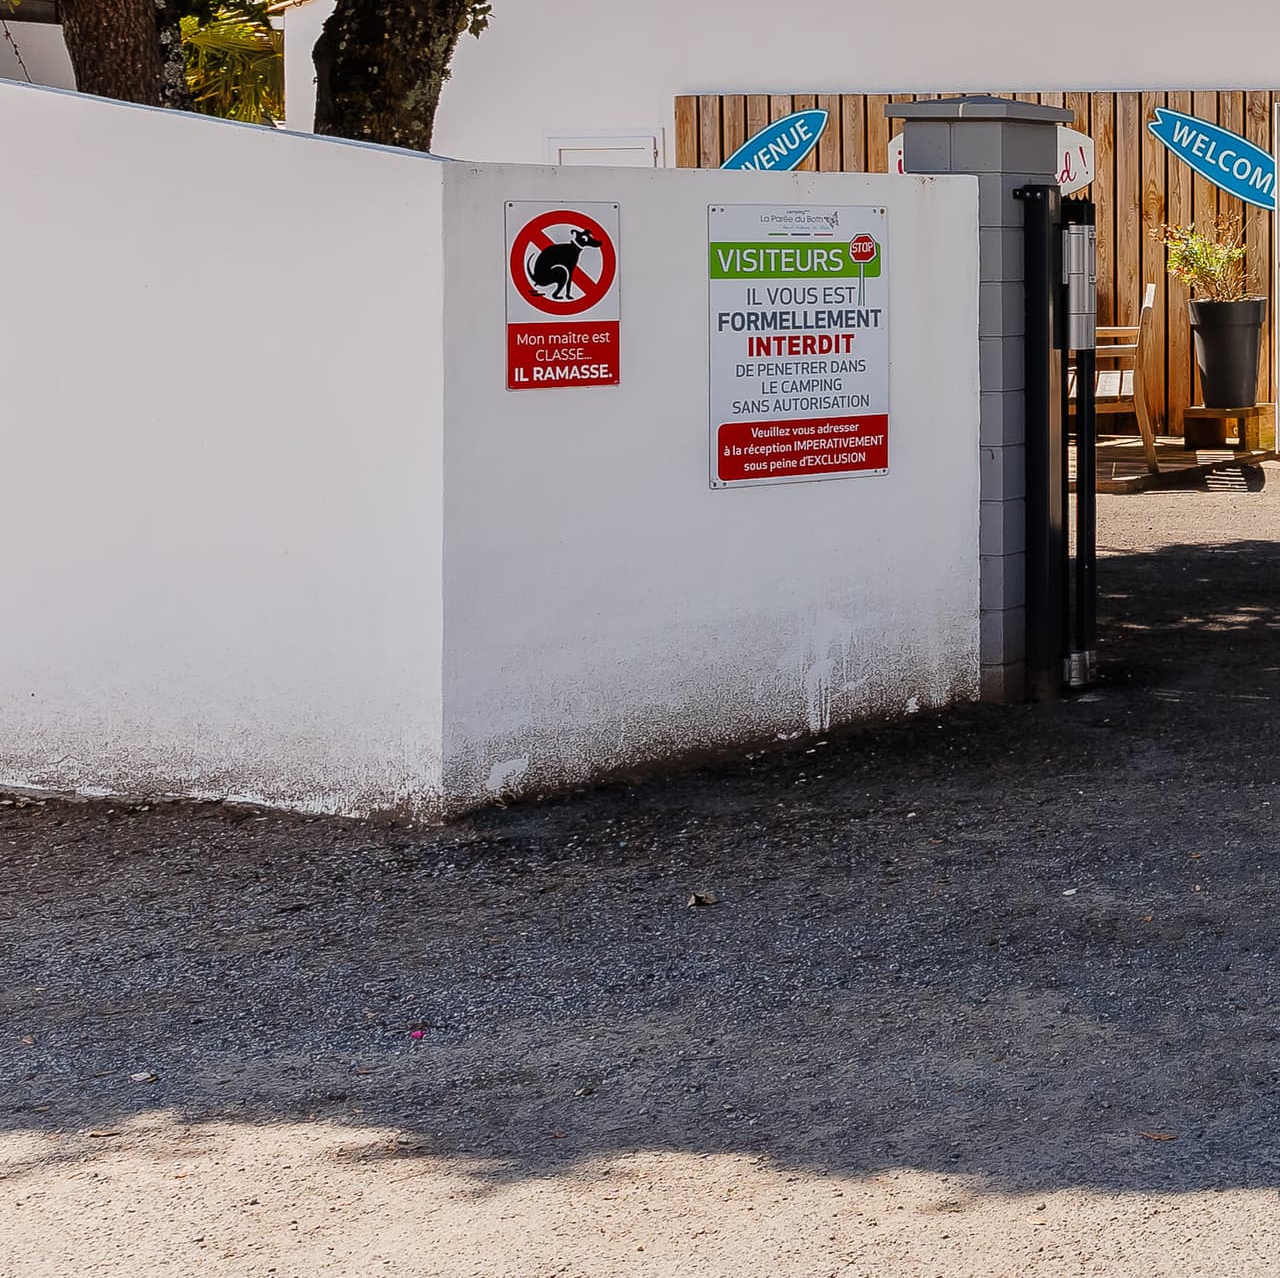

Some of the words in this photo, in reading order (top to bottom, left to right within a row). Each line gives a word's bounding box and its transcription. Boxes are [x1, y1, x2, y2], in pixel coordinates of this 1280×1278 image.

[851, 241, 873, 254] STOP
[717, 248, 844, 273] VISITEURS
[747, 287, 763, 306] IL
[766, 287, 819, 306] VOUS
[823, 286, 856, 304] EST
[718, 308, 882, 332] FORMELLEMENT
[516, 333, 545, 345] Mon
[592, 331, 611, 343] est
[748, 333, 855, 357] INTERDIT
[535, 347, 593, 362] CLASSE...
[514, 367, 529, 382] IL
[532, 363, 613, 381] RAMASSE.
[735, 363, 754, 378] DE
[757, 360, 828, 377] PENETRER
[830, 359, 866, 373] DANS
[761, 381, 778, 395] LE
[781, 378, 842, 394] CAMPING
[732, 399, 770, 414] SANS
[773, 394, 870, 412] AUTORISATION
[751, 426, 790, 438] Veuillez
[792, 425, 816, 436] vous
[817, 423, 860, 434] adresser
[723, 445, 731, 457] à
[732, 444, 742, 456] la
[743, 441, 792, 458] réception
[793, 434, 884, 451] IMPERATIVEMENT
[743, 460, 768, 471] sous
[769, 457, 798, 472] peine
[799, 451, 866, 467] d'EXCLUSION
